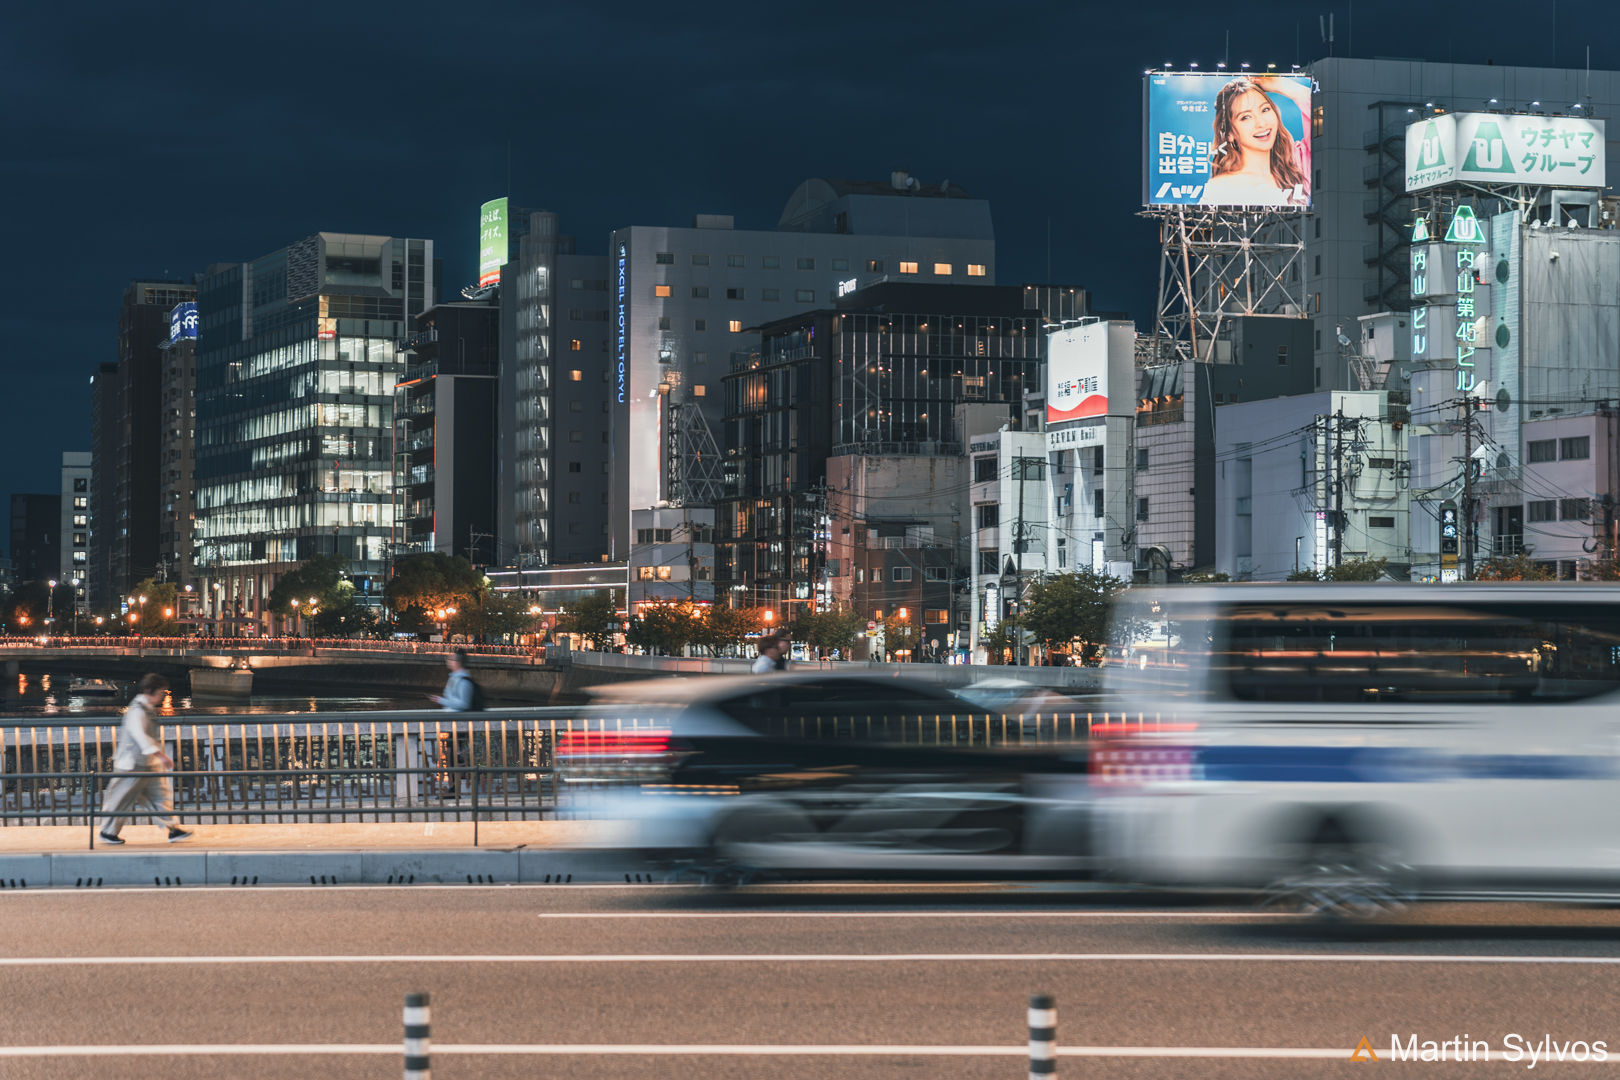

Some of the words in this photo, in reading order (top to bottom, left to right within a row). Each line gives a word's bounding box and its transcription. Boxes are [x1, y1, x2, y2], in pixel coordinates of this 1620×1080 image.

[1159, 131, 1228, 155] 自分らしく
[1520, 126, 1595, 150] ウチヤマ
[1159, 156, 1208, 174] 出会う
[1520, 151, 1596, 175] グループ
[1407, 165, 1455, 187] ウチヤマグループ
[618, 258, 626, 302] EXCEL
[1413, 250, 1426, 355] 内山ビル
[618, 304, 626, 352] HOTEL
[1455, 248, 1476, 391] 内山第45ビル
[618, 353, 626, 403] TOKYU
[1050, 430, 1076, 445] SEVEN
